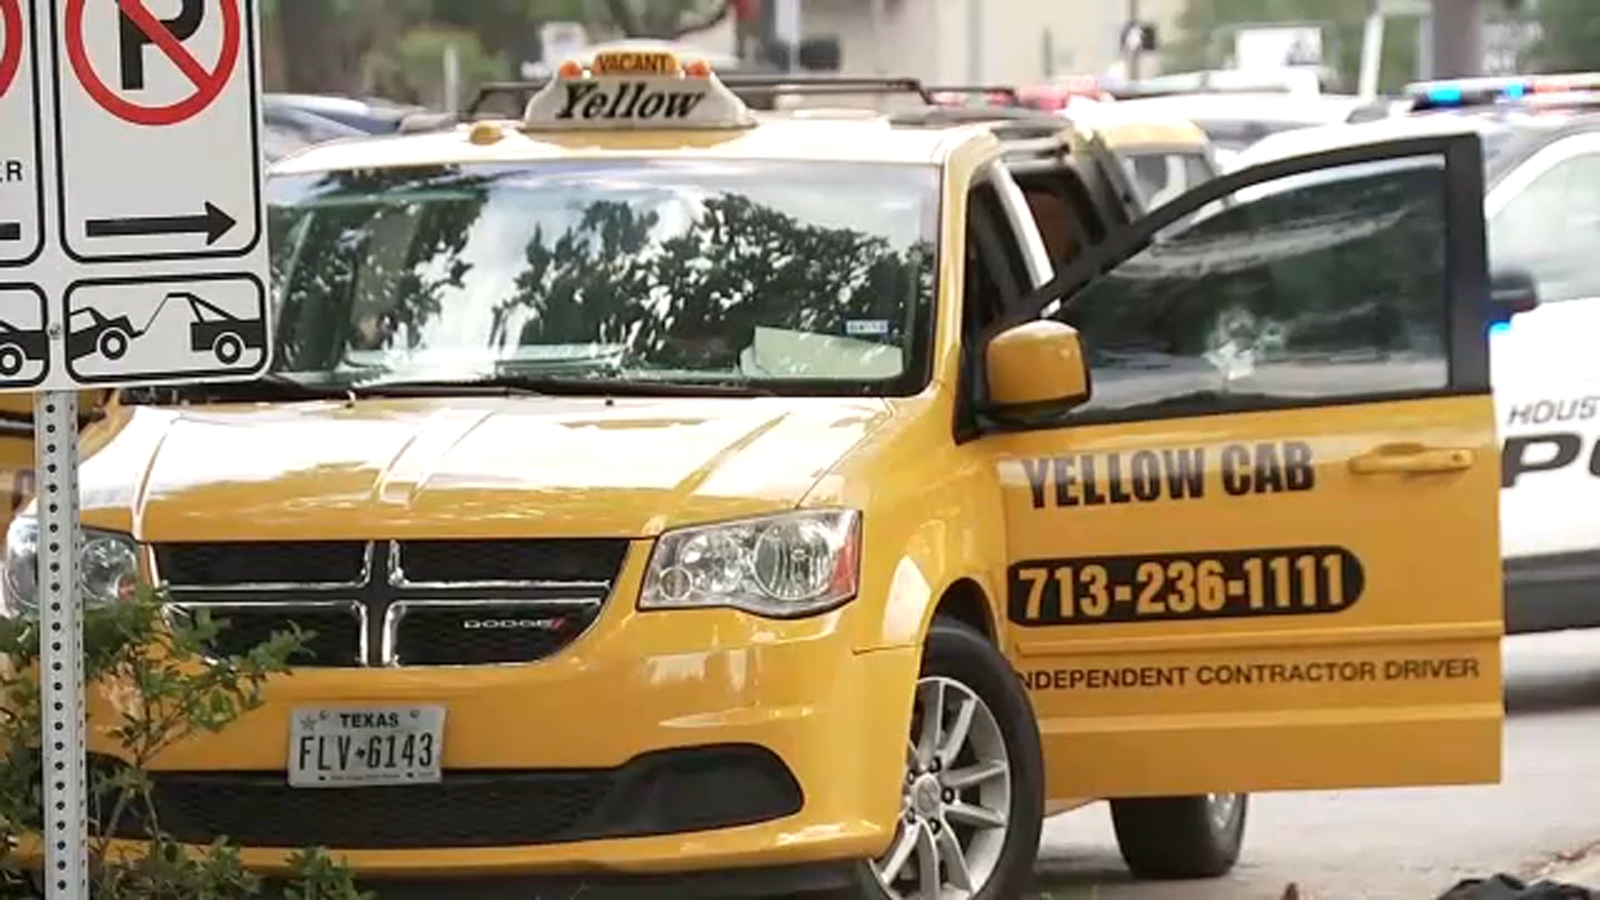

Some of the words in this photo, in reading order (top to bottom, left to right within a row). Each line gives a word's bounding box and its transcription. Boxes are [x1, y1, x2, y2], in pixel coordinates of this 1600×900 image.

[598, 53, 668, 72] VACANT
[555, 80, 705, 120] Yellow
[0, 160, 23, 182] R
[1024, 447, 1205, 510] YELLOW
[1221, 440, 1315, 496] CAB
[1500, 431, 1600, 489] P
[1018, 553, 1344, 620] 713-236-1111
[463, 619, 552, 629] DODGE
[1016, 666, 1189, 690] NDEPENDENT
[1196, 660, 1376, 685] CONTRACTOR
[1384, 657, 1480, 680] DRIVER
[339, 712, 400, 728] TEXAS
